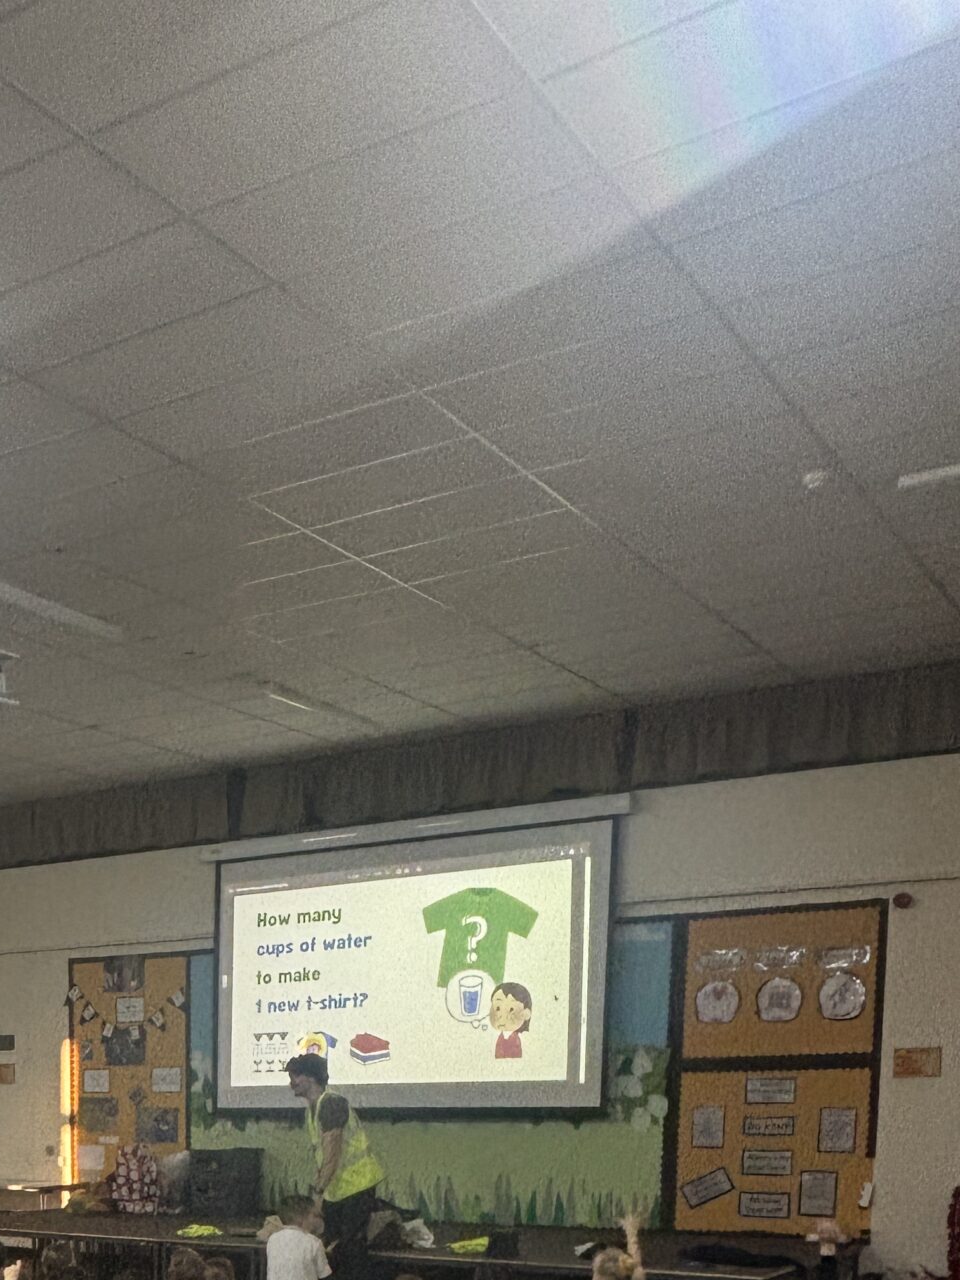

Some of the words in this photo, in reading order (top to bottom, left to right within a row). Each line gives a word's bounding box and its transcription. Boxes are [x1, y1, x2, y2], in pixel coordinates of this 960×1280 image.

[257, 912, 291, 927] How
[297, 908, 341, 924] many
[257, 942, 293, 957] cups
[300, 937, 316, 952] of
[323, 933, 372, 951] water
[462, 915, 488, 964] ?
[256, 970, 272, 985] to
[278, 967, 321, 983] make
[267, 999, 300, 1013] new
[306, 992, 369, 1010] t-shirt?
